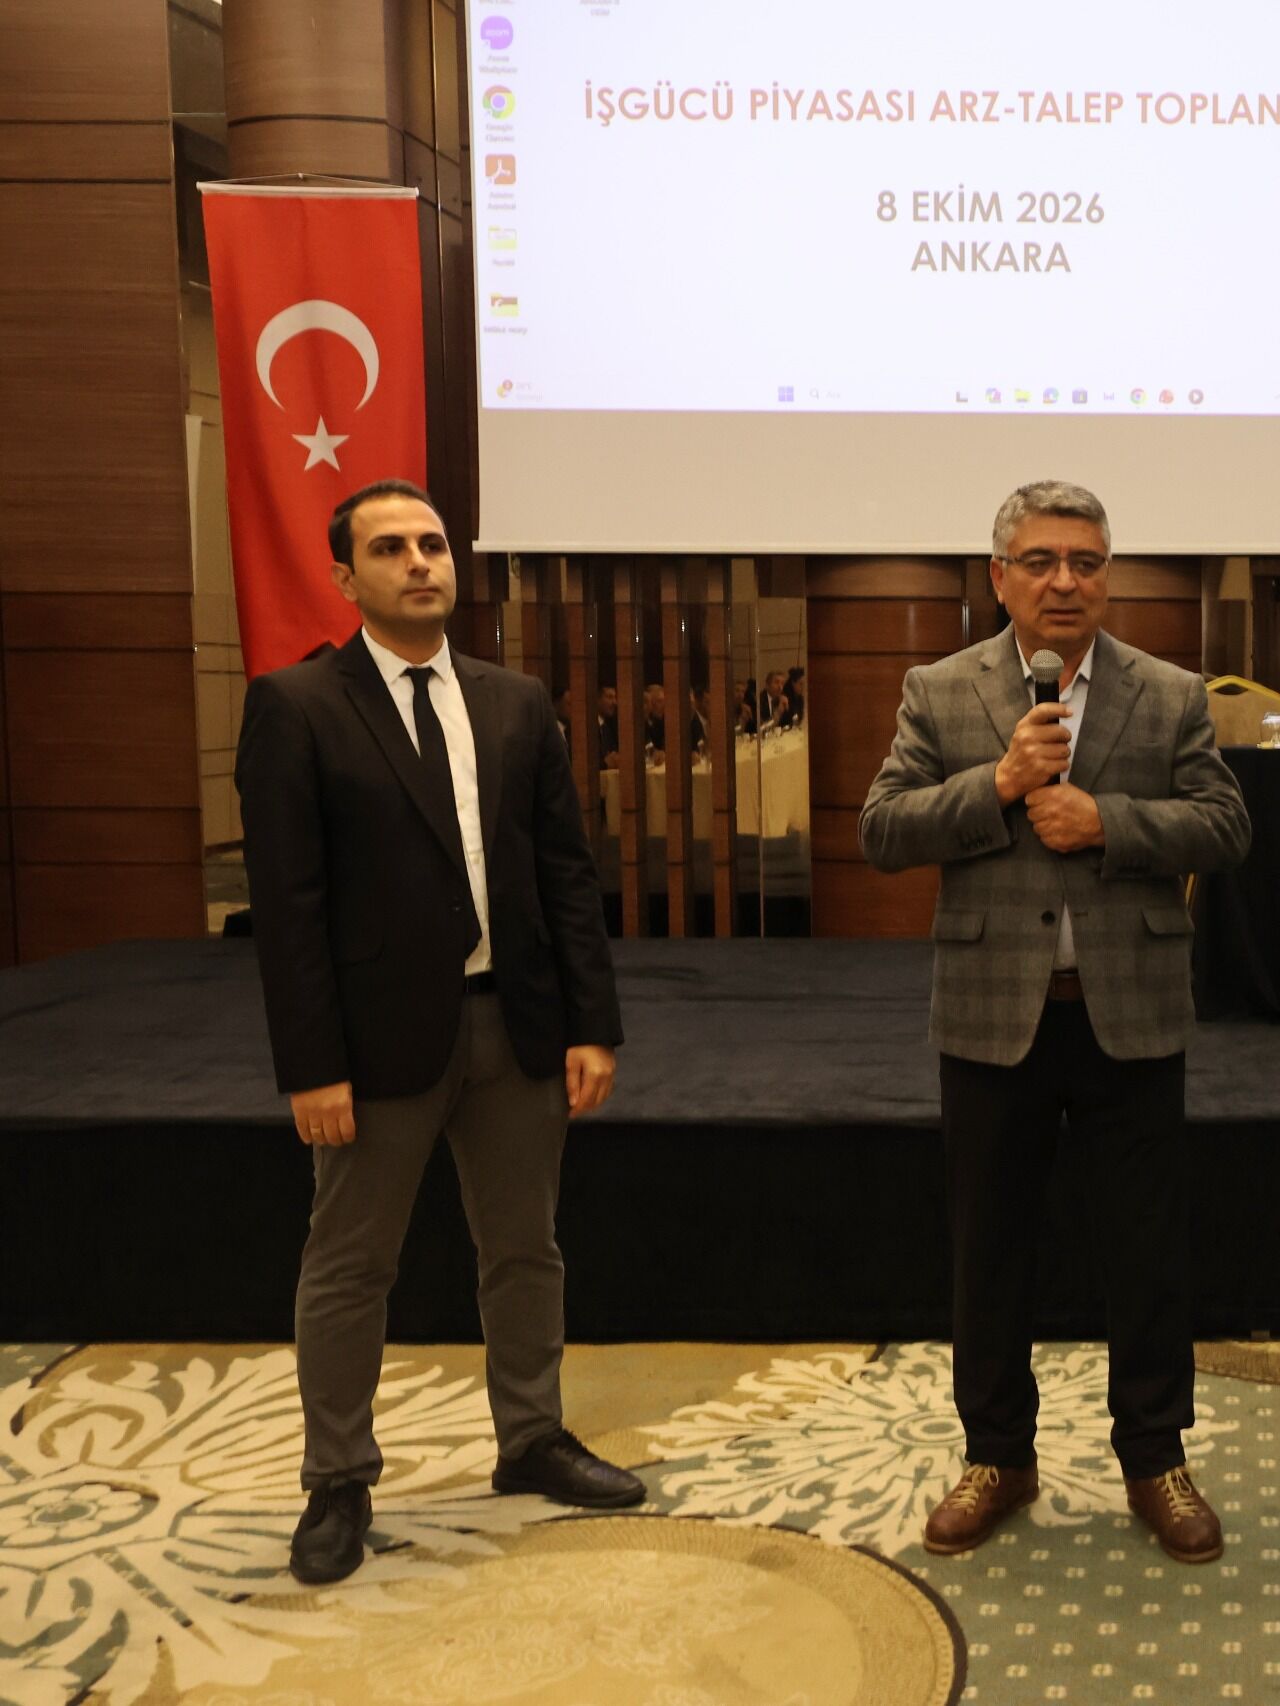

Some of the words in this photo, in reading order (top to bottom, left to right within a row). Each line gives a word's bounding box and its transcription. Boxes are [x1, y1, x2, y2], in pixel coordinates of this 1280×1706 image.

[585, 80, 733, 127] İŞGÜCÜ
[750, 81, 914, 121] PİYASASI
[930, 91, 1123, 123] ARZ-TALEP
[876, 191, 897, 221] 8
[913, 183, 1003, 222] EKİM
[1016, 191, 1105, 223] 2026
[911, 241, 1072, 272] ANKARA
